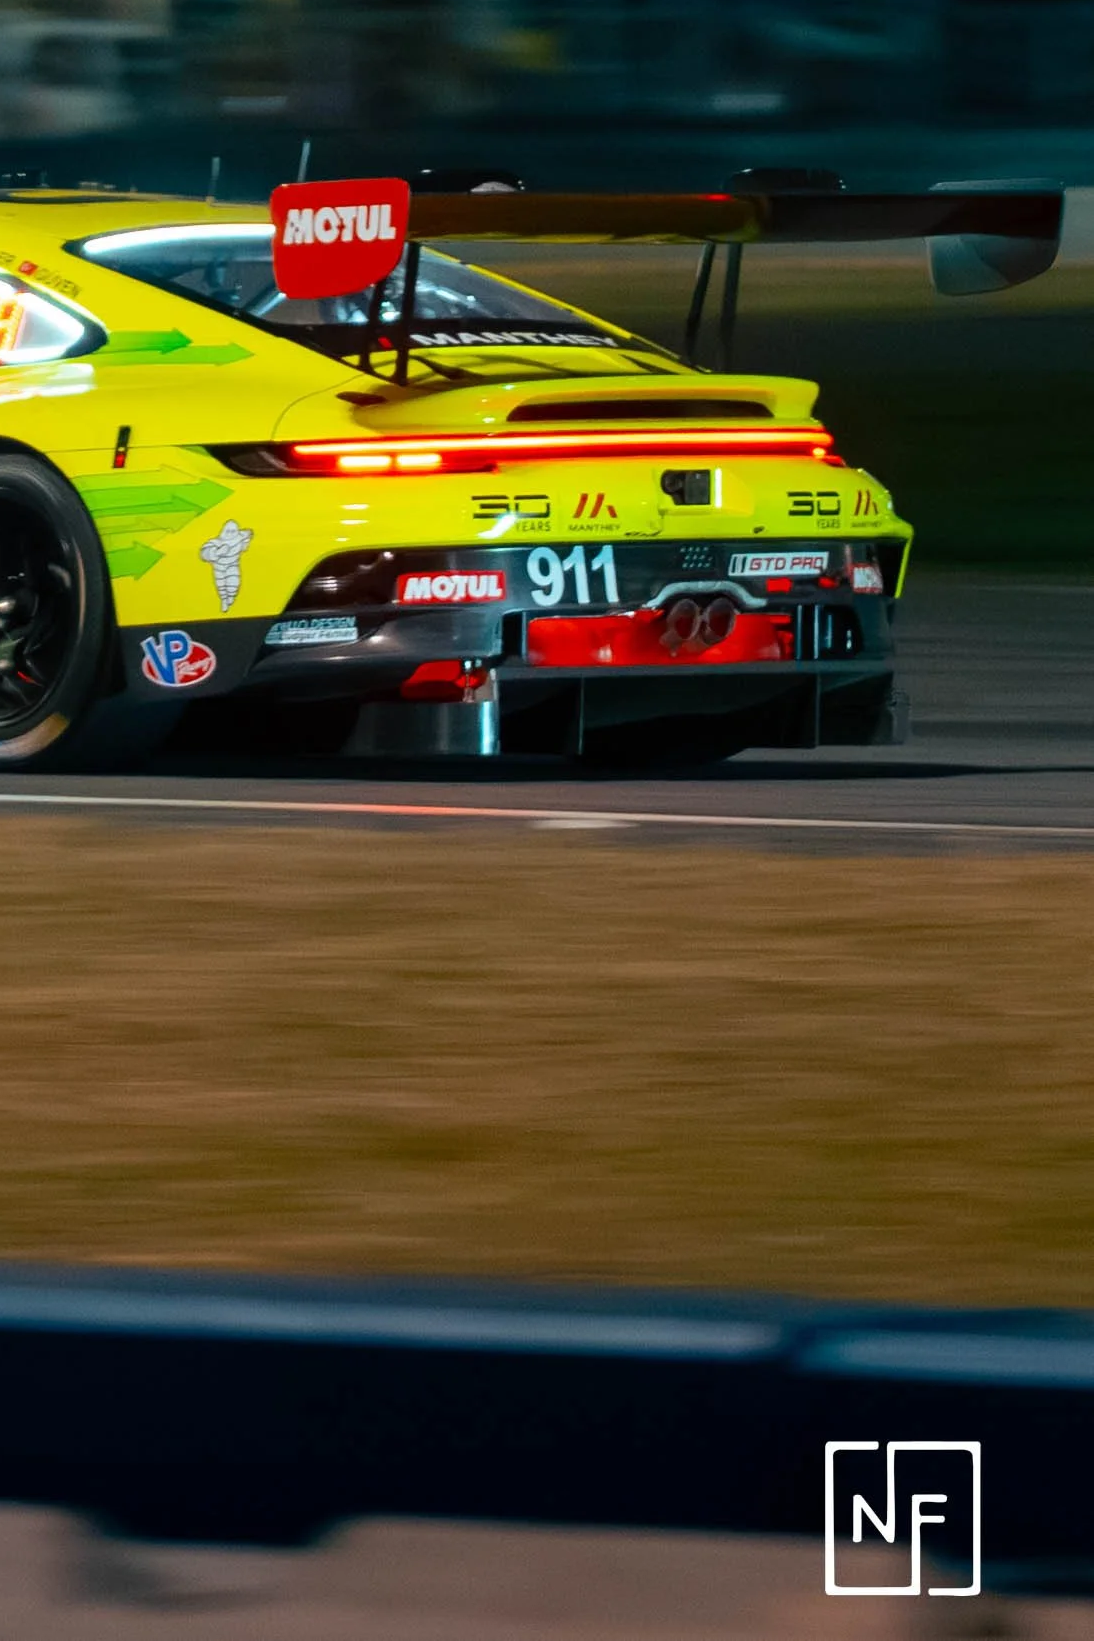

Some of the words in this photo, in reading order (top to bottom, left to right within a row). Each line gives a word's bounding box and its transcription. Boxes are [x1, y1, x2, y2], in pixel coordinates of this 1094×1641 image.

[283, 204, 397, 245] MOTUL
[410, 332, 618, 347] MANTHEY
[471, 495, 551, 518] 30
[787, 491, 841, 516] 30
[515, 521, 551, 532] YEARS
[568, 523, 621, 532] MANTHEY
[527, 544, 620, 607] 911
[749, 557, 786, 571] GTD
[790, 556, 825, 571] PRO
[404, 575, 503, 600] MOTUL
[141, 630, 192, 686] VP
